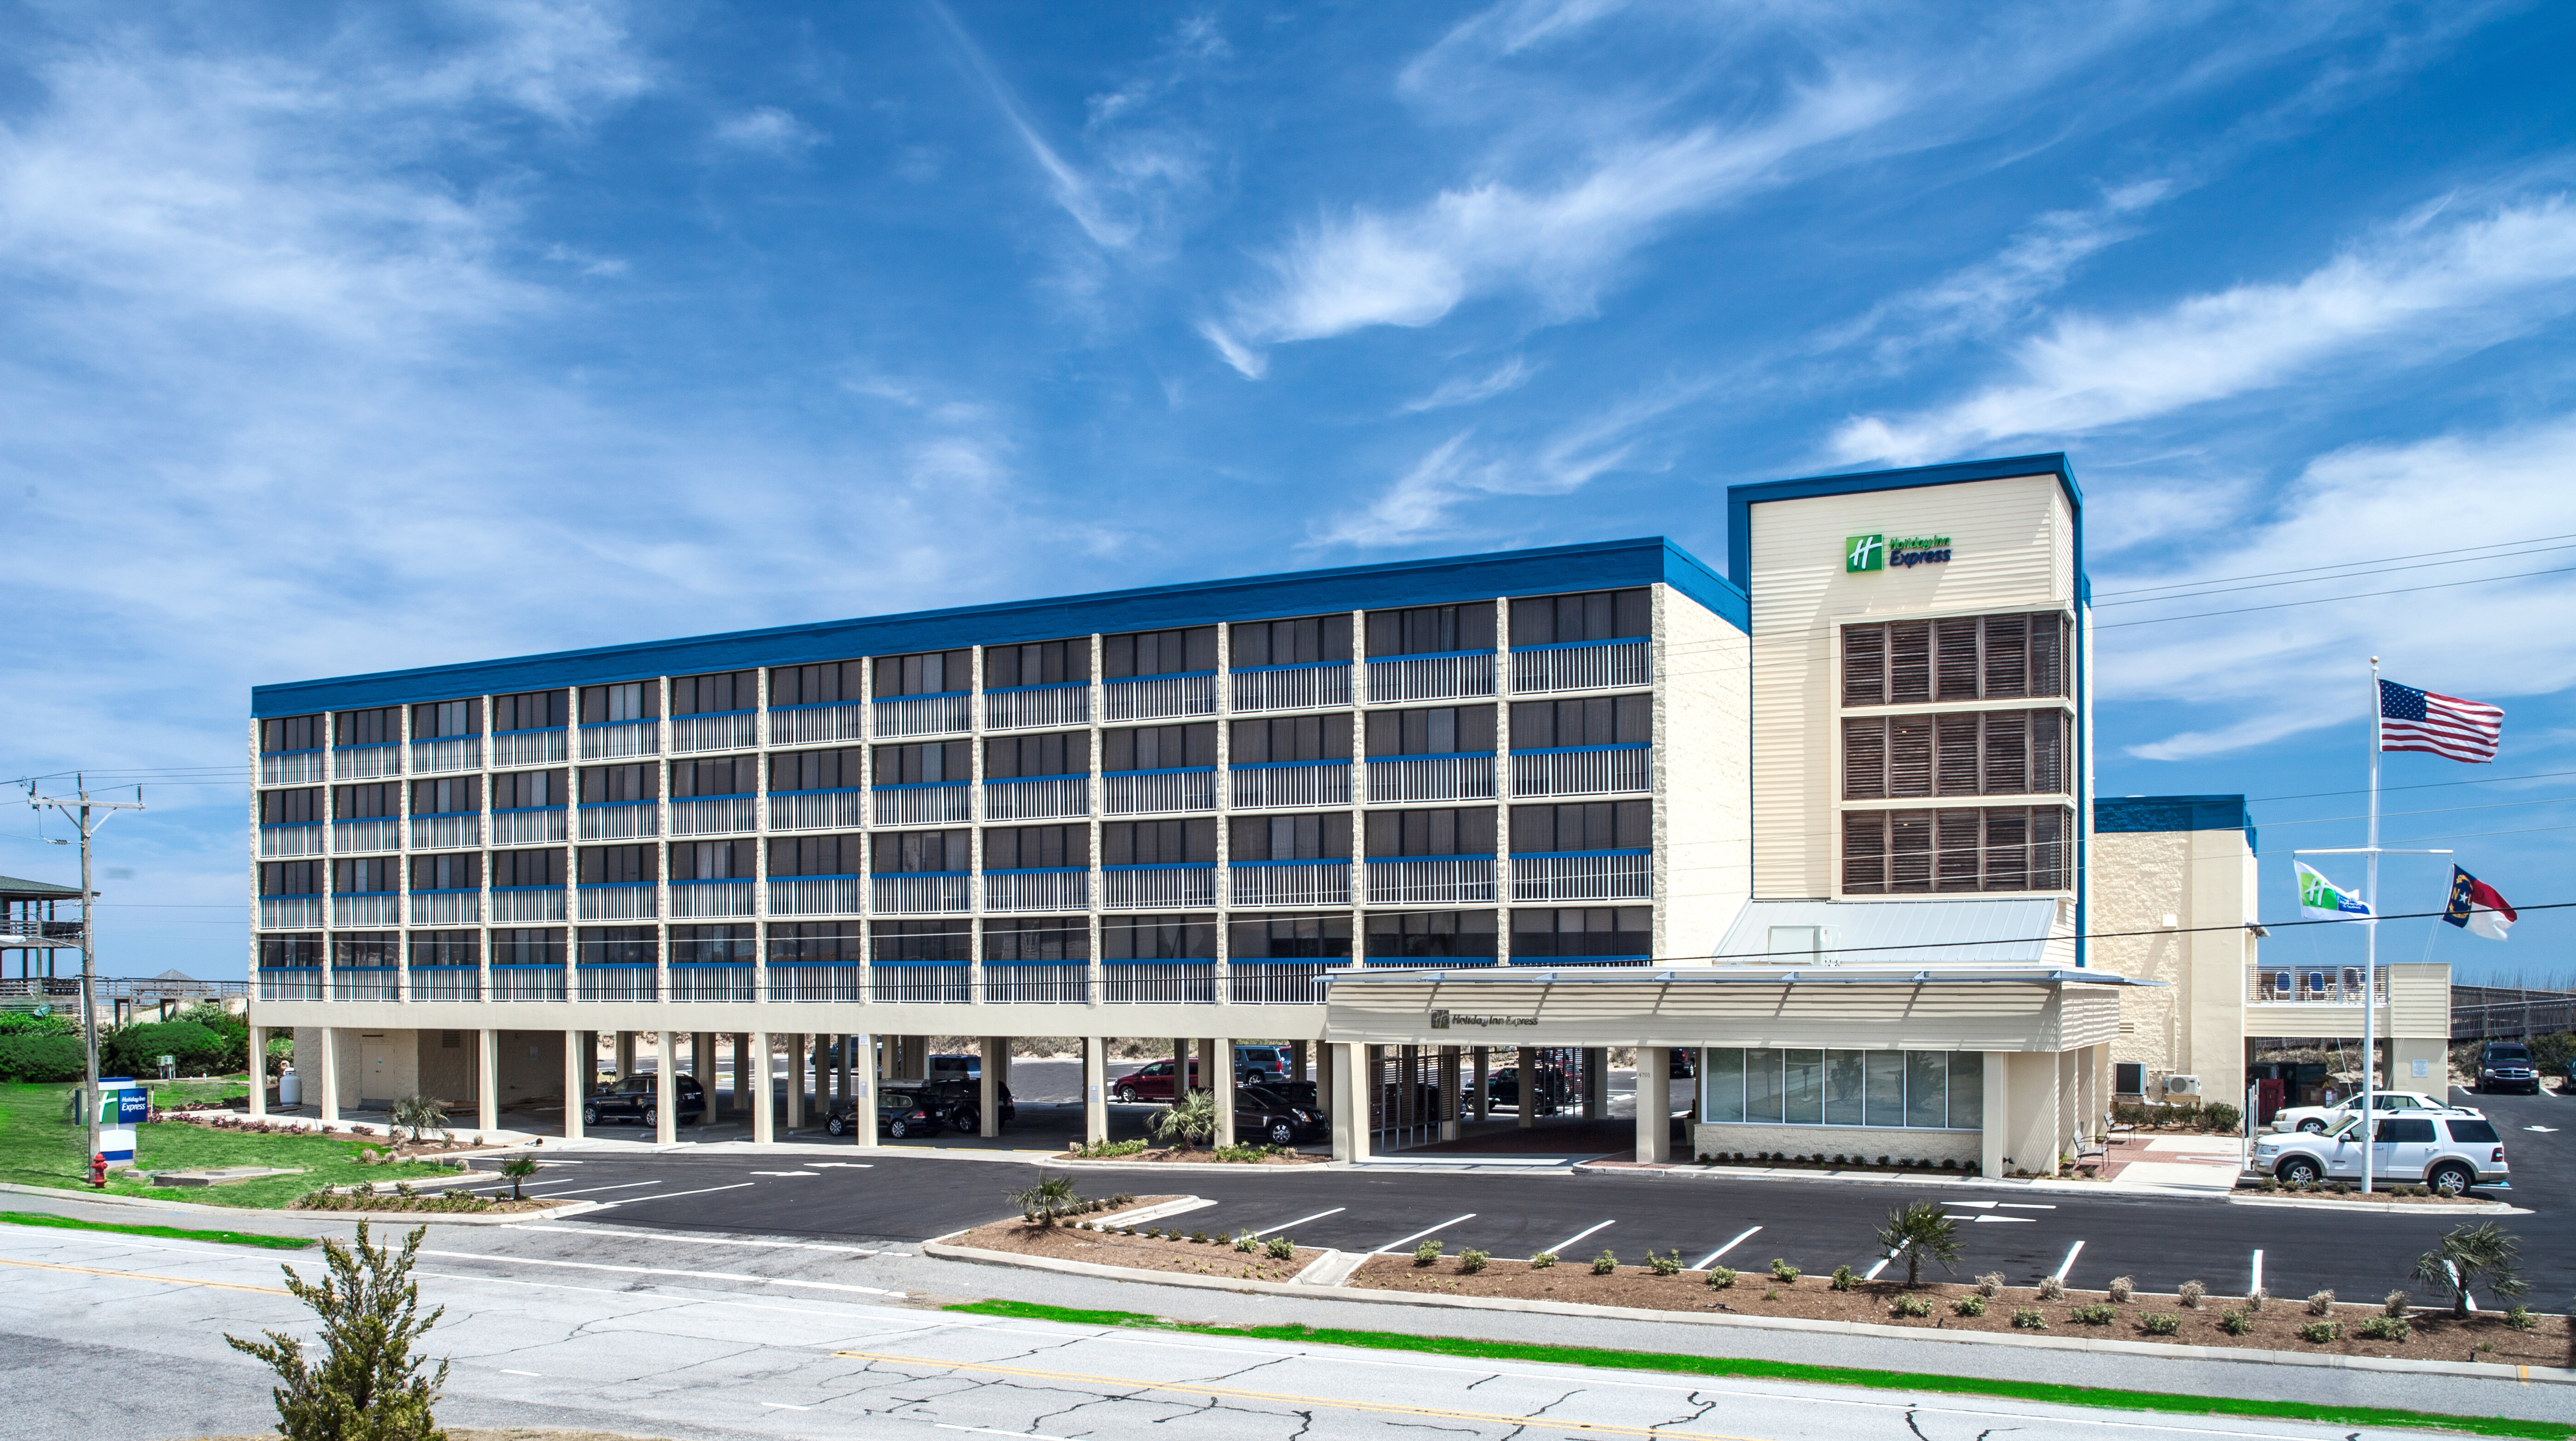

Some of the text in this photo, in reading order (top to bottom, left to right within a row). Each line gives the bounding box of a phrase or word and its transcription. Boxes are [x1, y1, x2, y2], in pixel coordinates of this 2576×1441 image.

[1889, 534, 1950, 550] Holiday Inn
[1889, 549, 1951, 568] Express
[2452, 887, 2460, 900] N
[1452, 1014, 1538, 1027] Holiday Inn Express
[122, 1103, 146, 1112] Express
